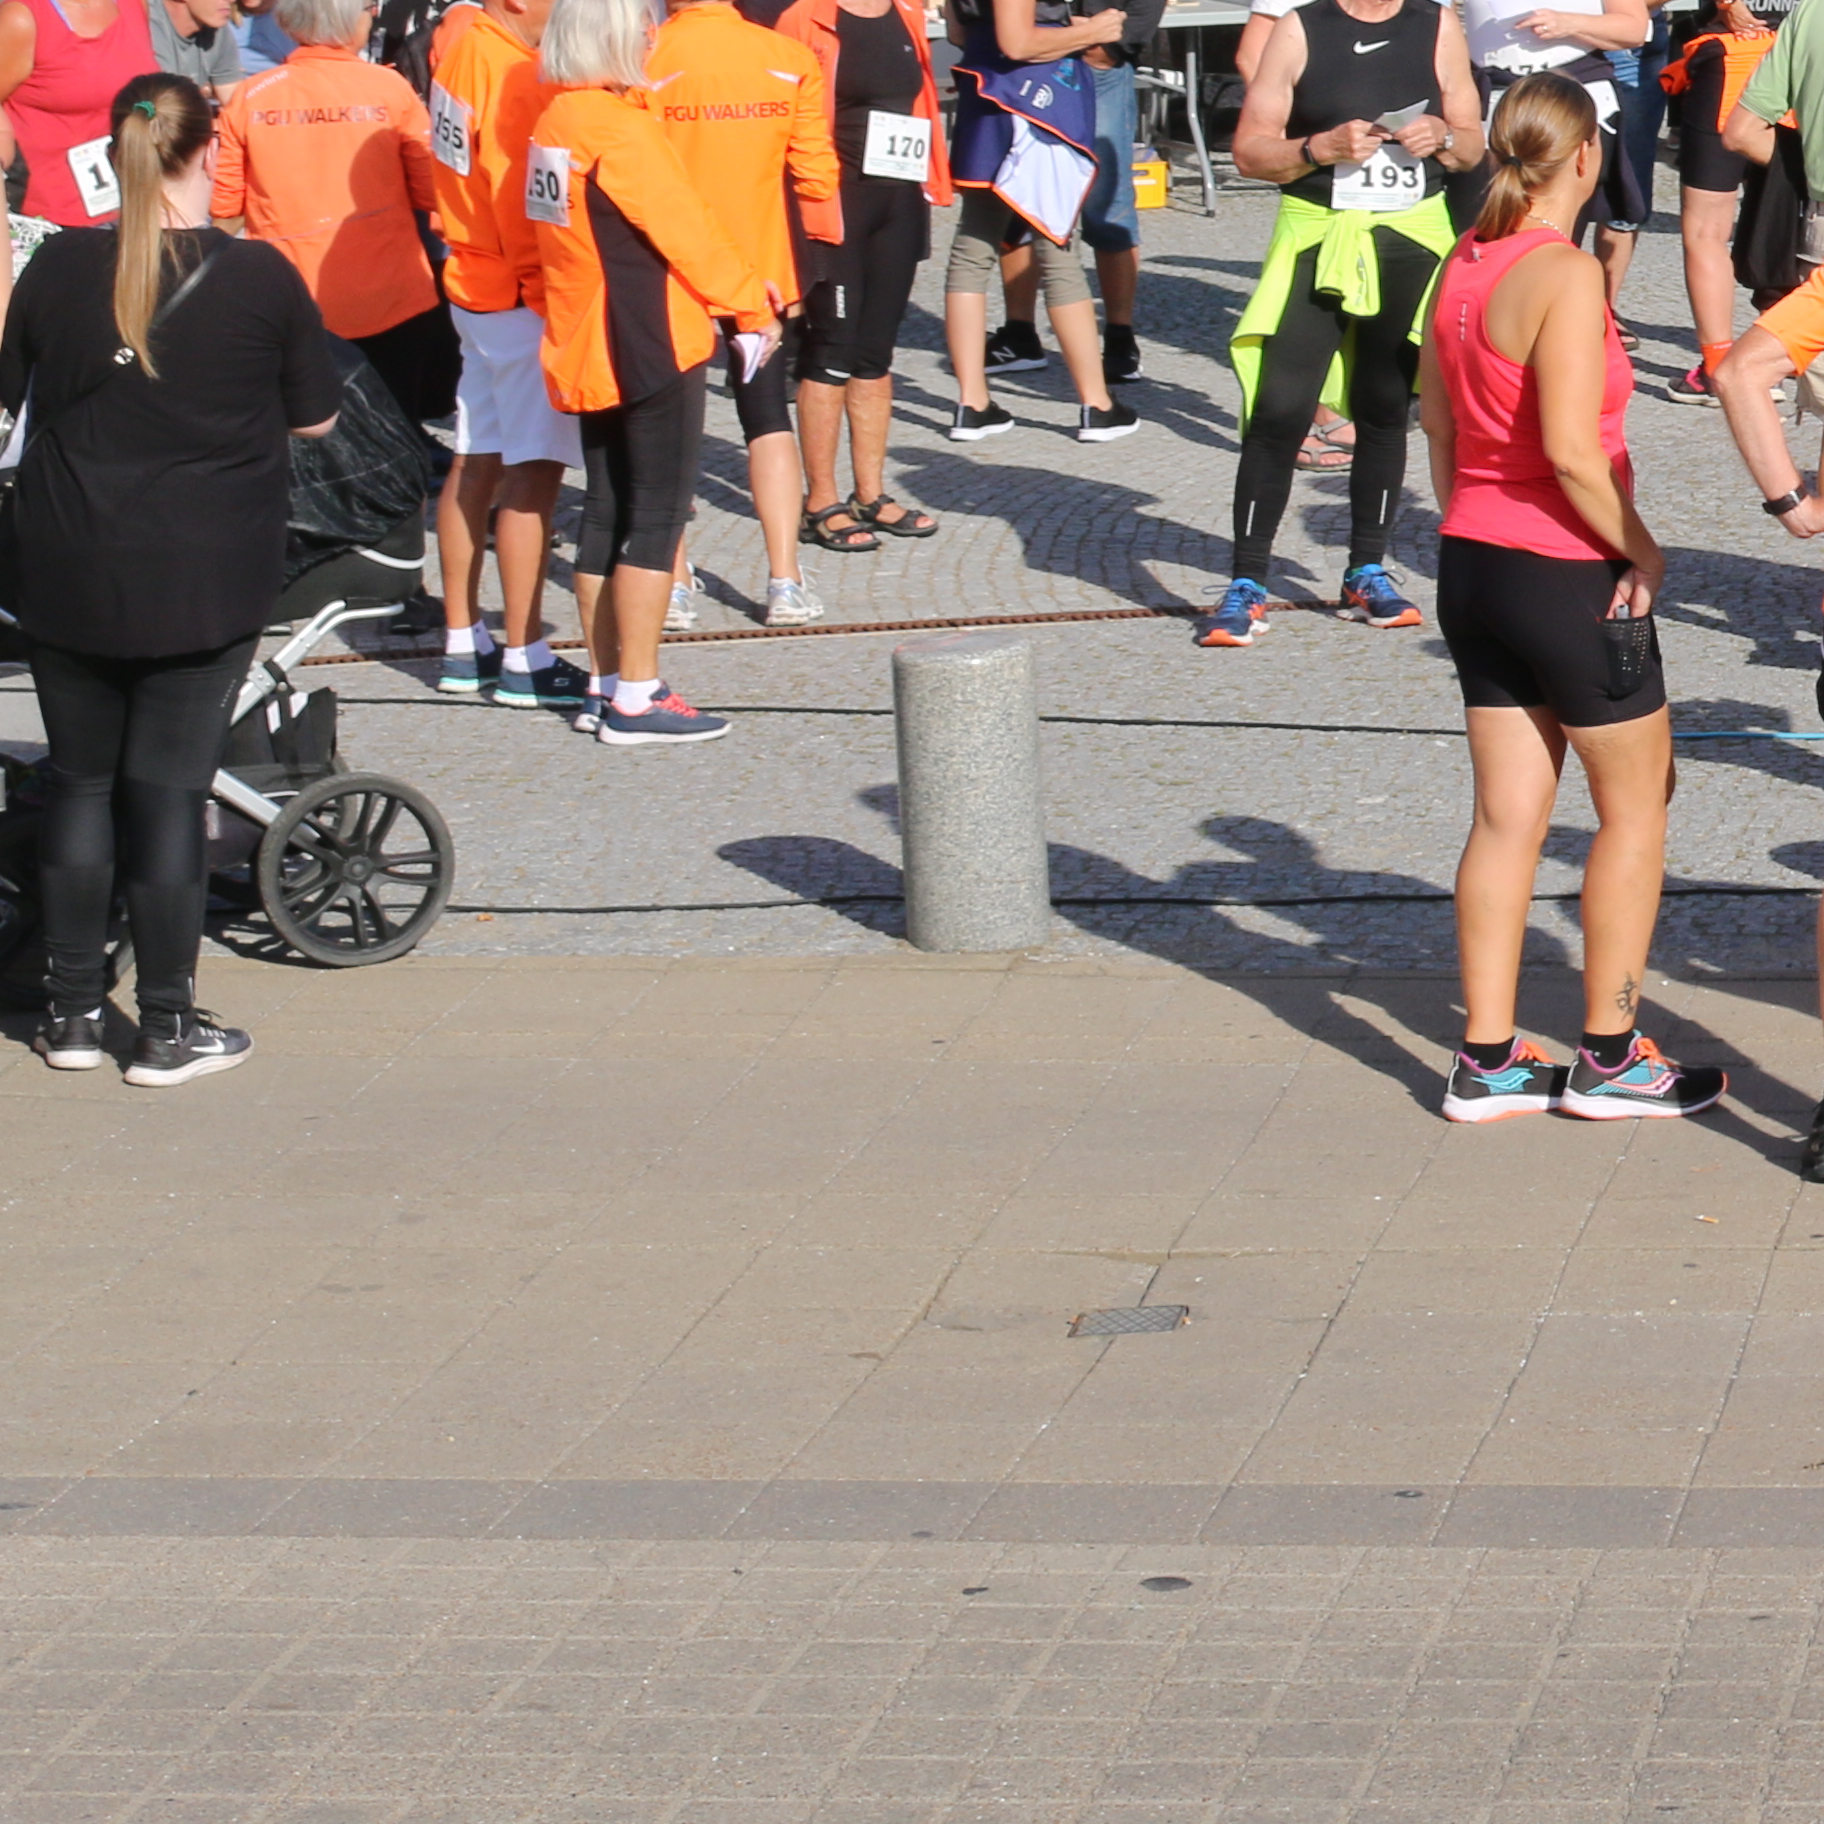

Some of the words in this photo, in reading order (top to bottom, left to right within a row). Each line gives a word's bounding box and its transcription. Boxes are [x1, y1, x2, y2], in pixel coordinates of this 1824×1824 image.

[252, 108, 291, 126] PGU
[295, 104, 388, 125] WALKERS
[662, 104, 699, 122] PGU
[701, 100, 790, 121] WALKERS
[434, 111, 463, 150] 155
[887, 134, 927, 160] 170
[1361, 164, 1419, 189] 193
